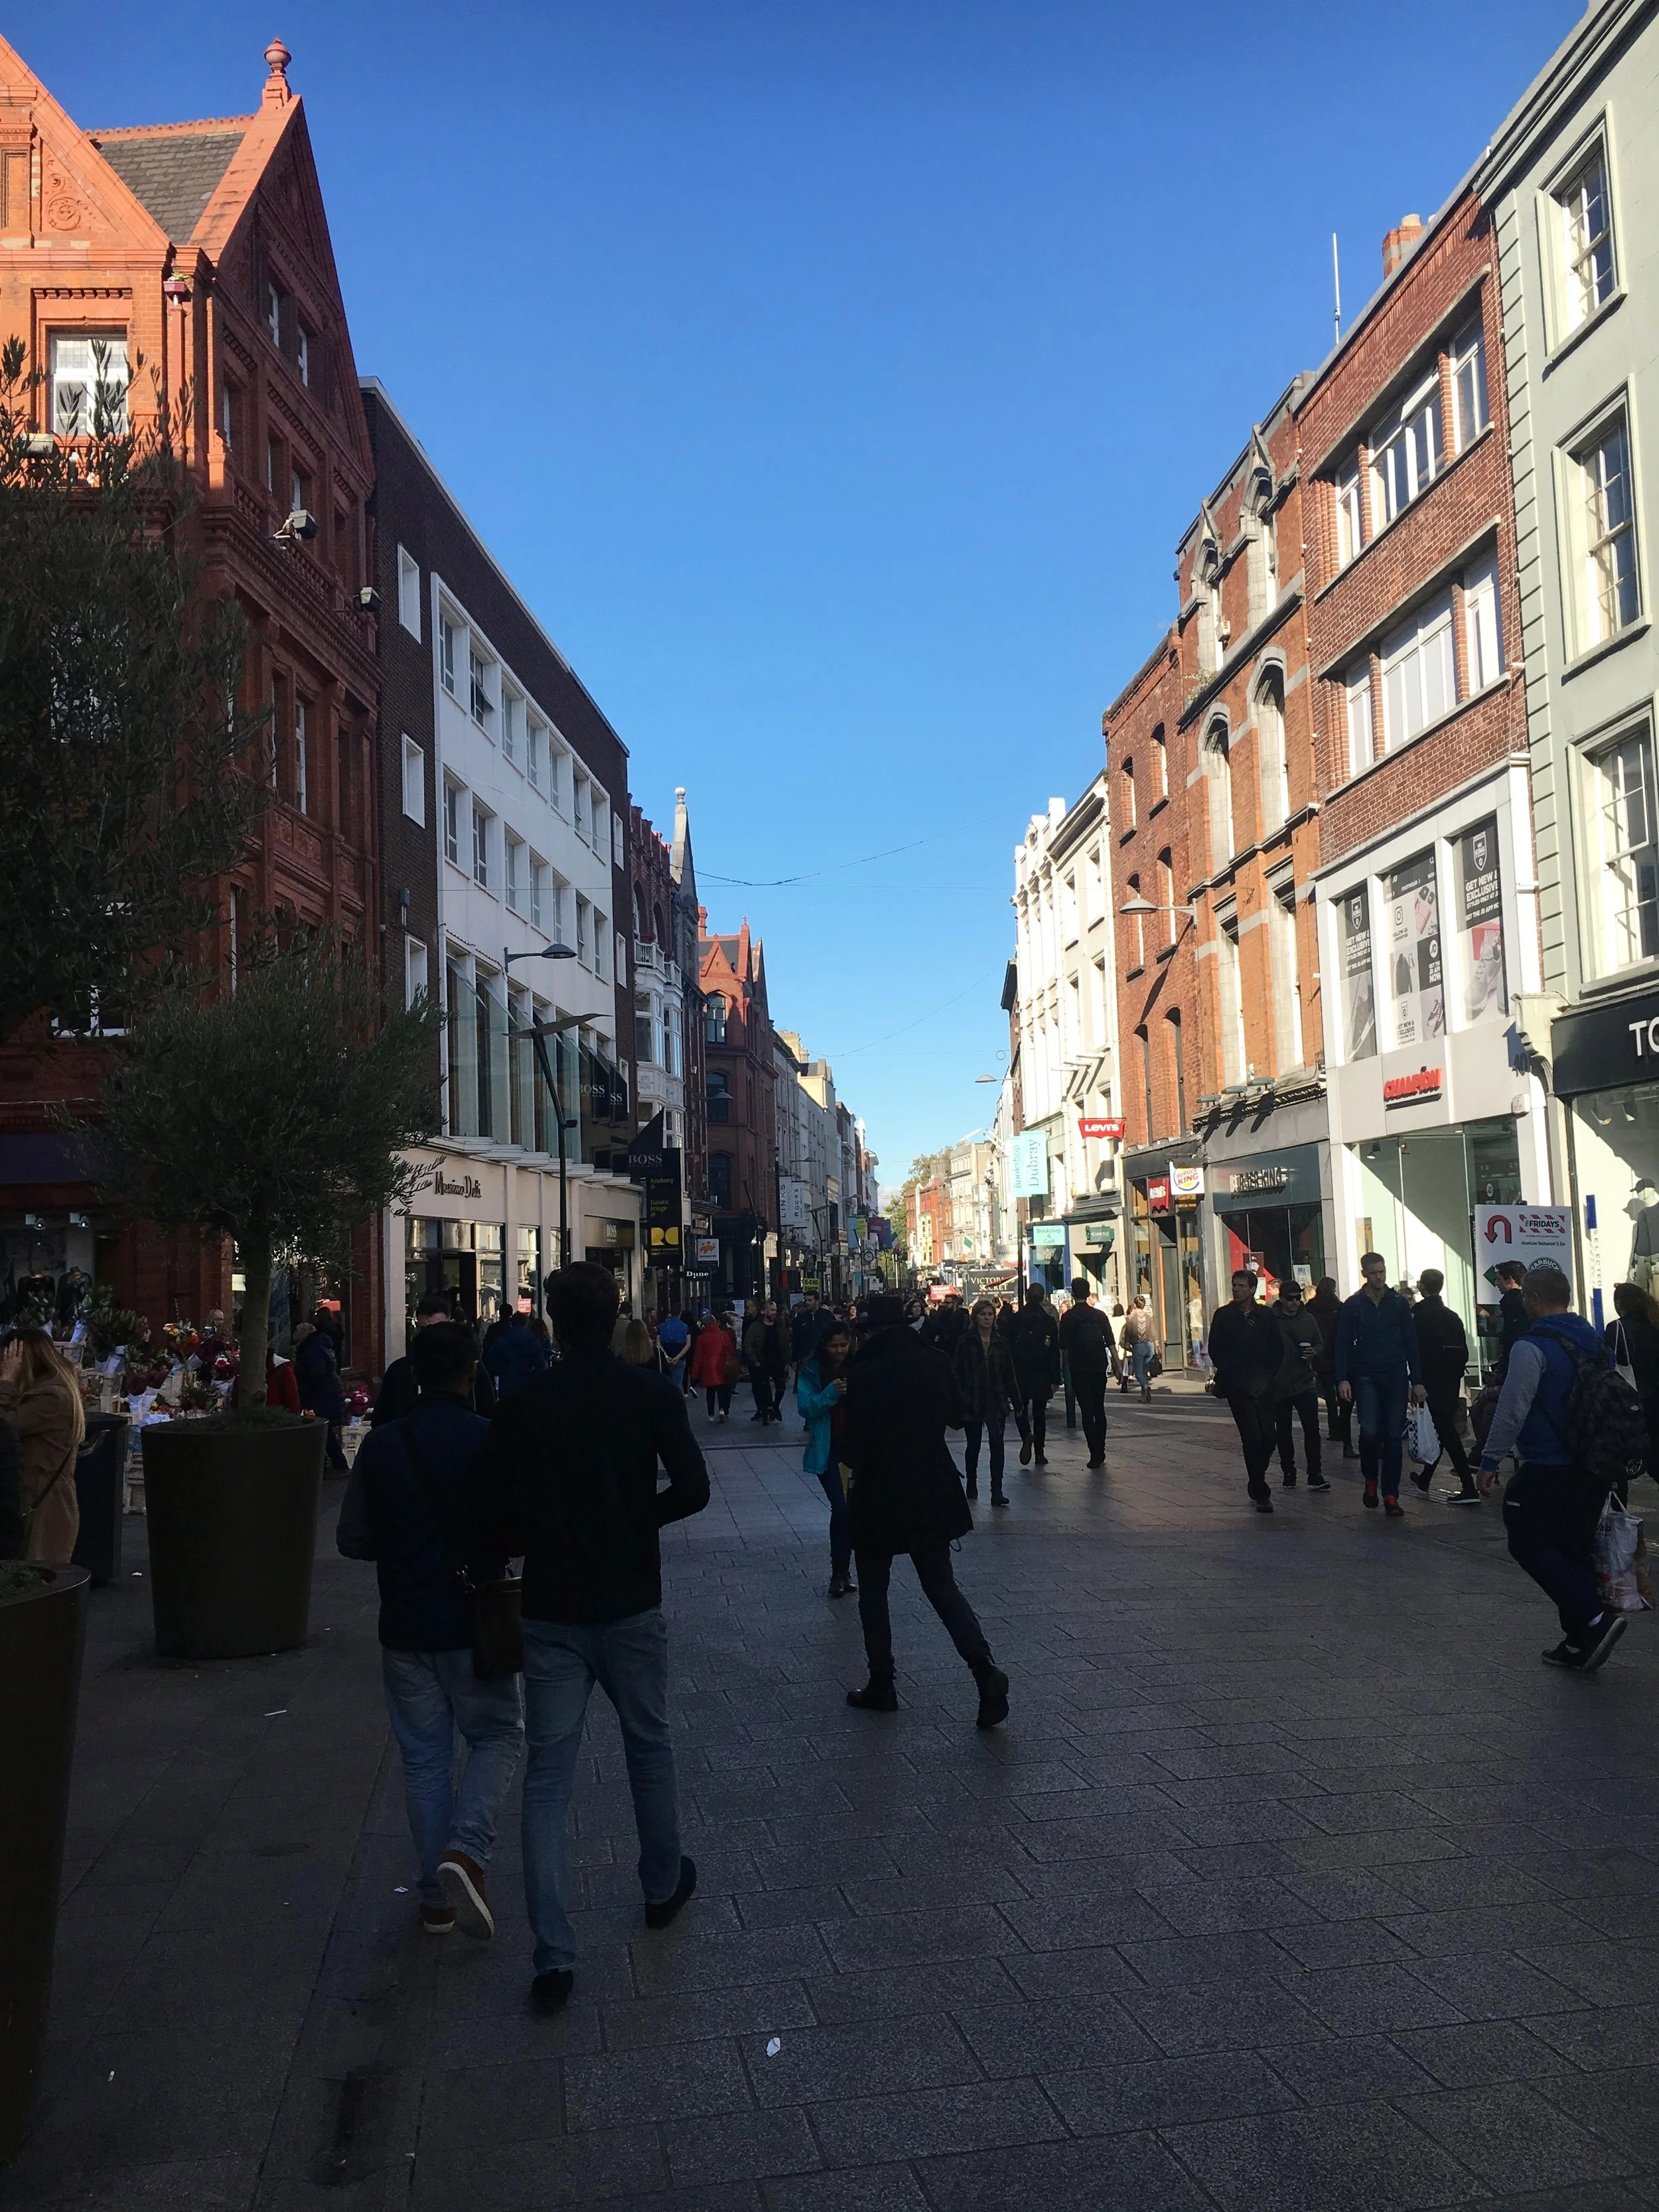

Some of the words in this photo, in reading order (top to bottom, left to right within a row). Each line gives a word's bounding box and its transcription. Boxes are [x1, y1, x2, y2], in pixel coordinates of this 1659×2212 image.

[1401, 880, 1417, 892] FOOTWEAR
[1466, 878, 1478, 892] GET
[1478, 871, 1493, 887] NEW
[1467, 898, 1480, 909] STYLES
[1480, 895, 1489, 904] ONLY
[1346, 935, 1355, 946] GET
[1355, 930, 1366, 942] NEW
[1429, 972, 1441, 984] NOW
[1384, 1069, 1441, 1098] CHAMPION
[628, 1154, 663, 1164] BOSS
[1027, 1139, 1041, 1187] Dubray
[1012, 1145, 1021, 1188] Bookshop
[1177, 1166, 1197, 1179] BURGER
[1177, 1173, 1198, 1186] KING
[1530, 1258, 1559, 1270] TARBUCK
